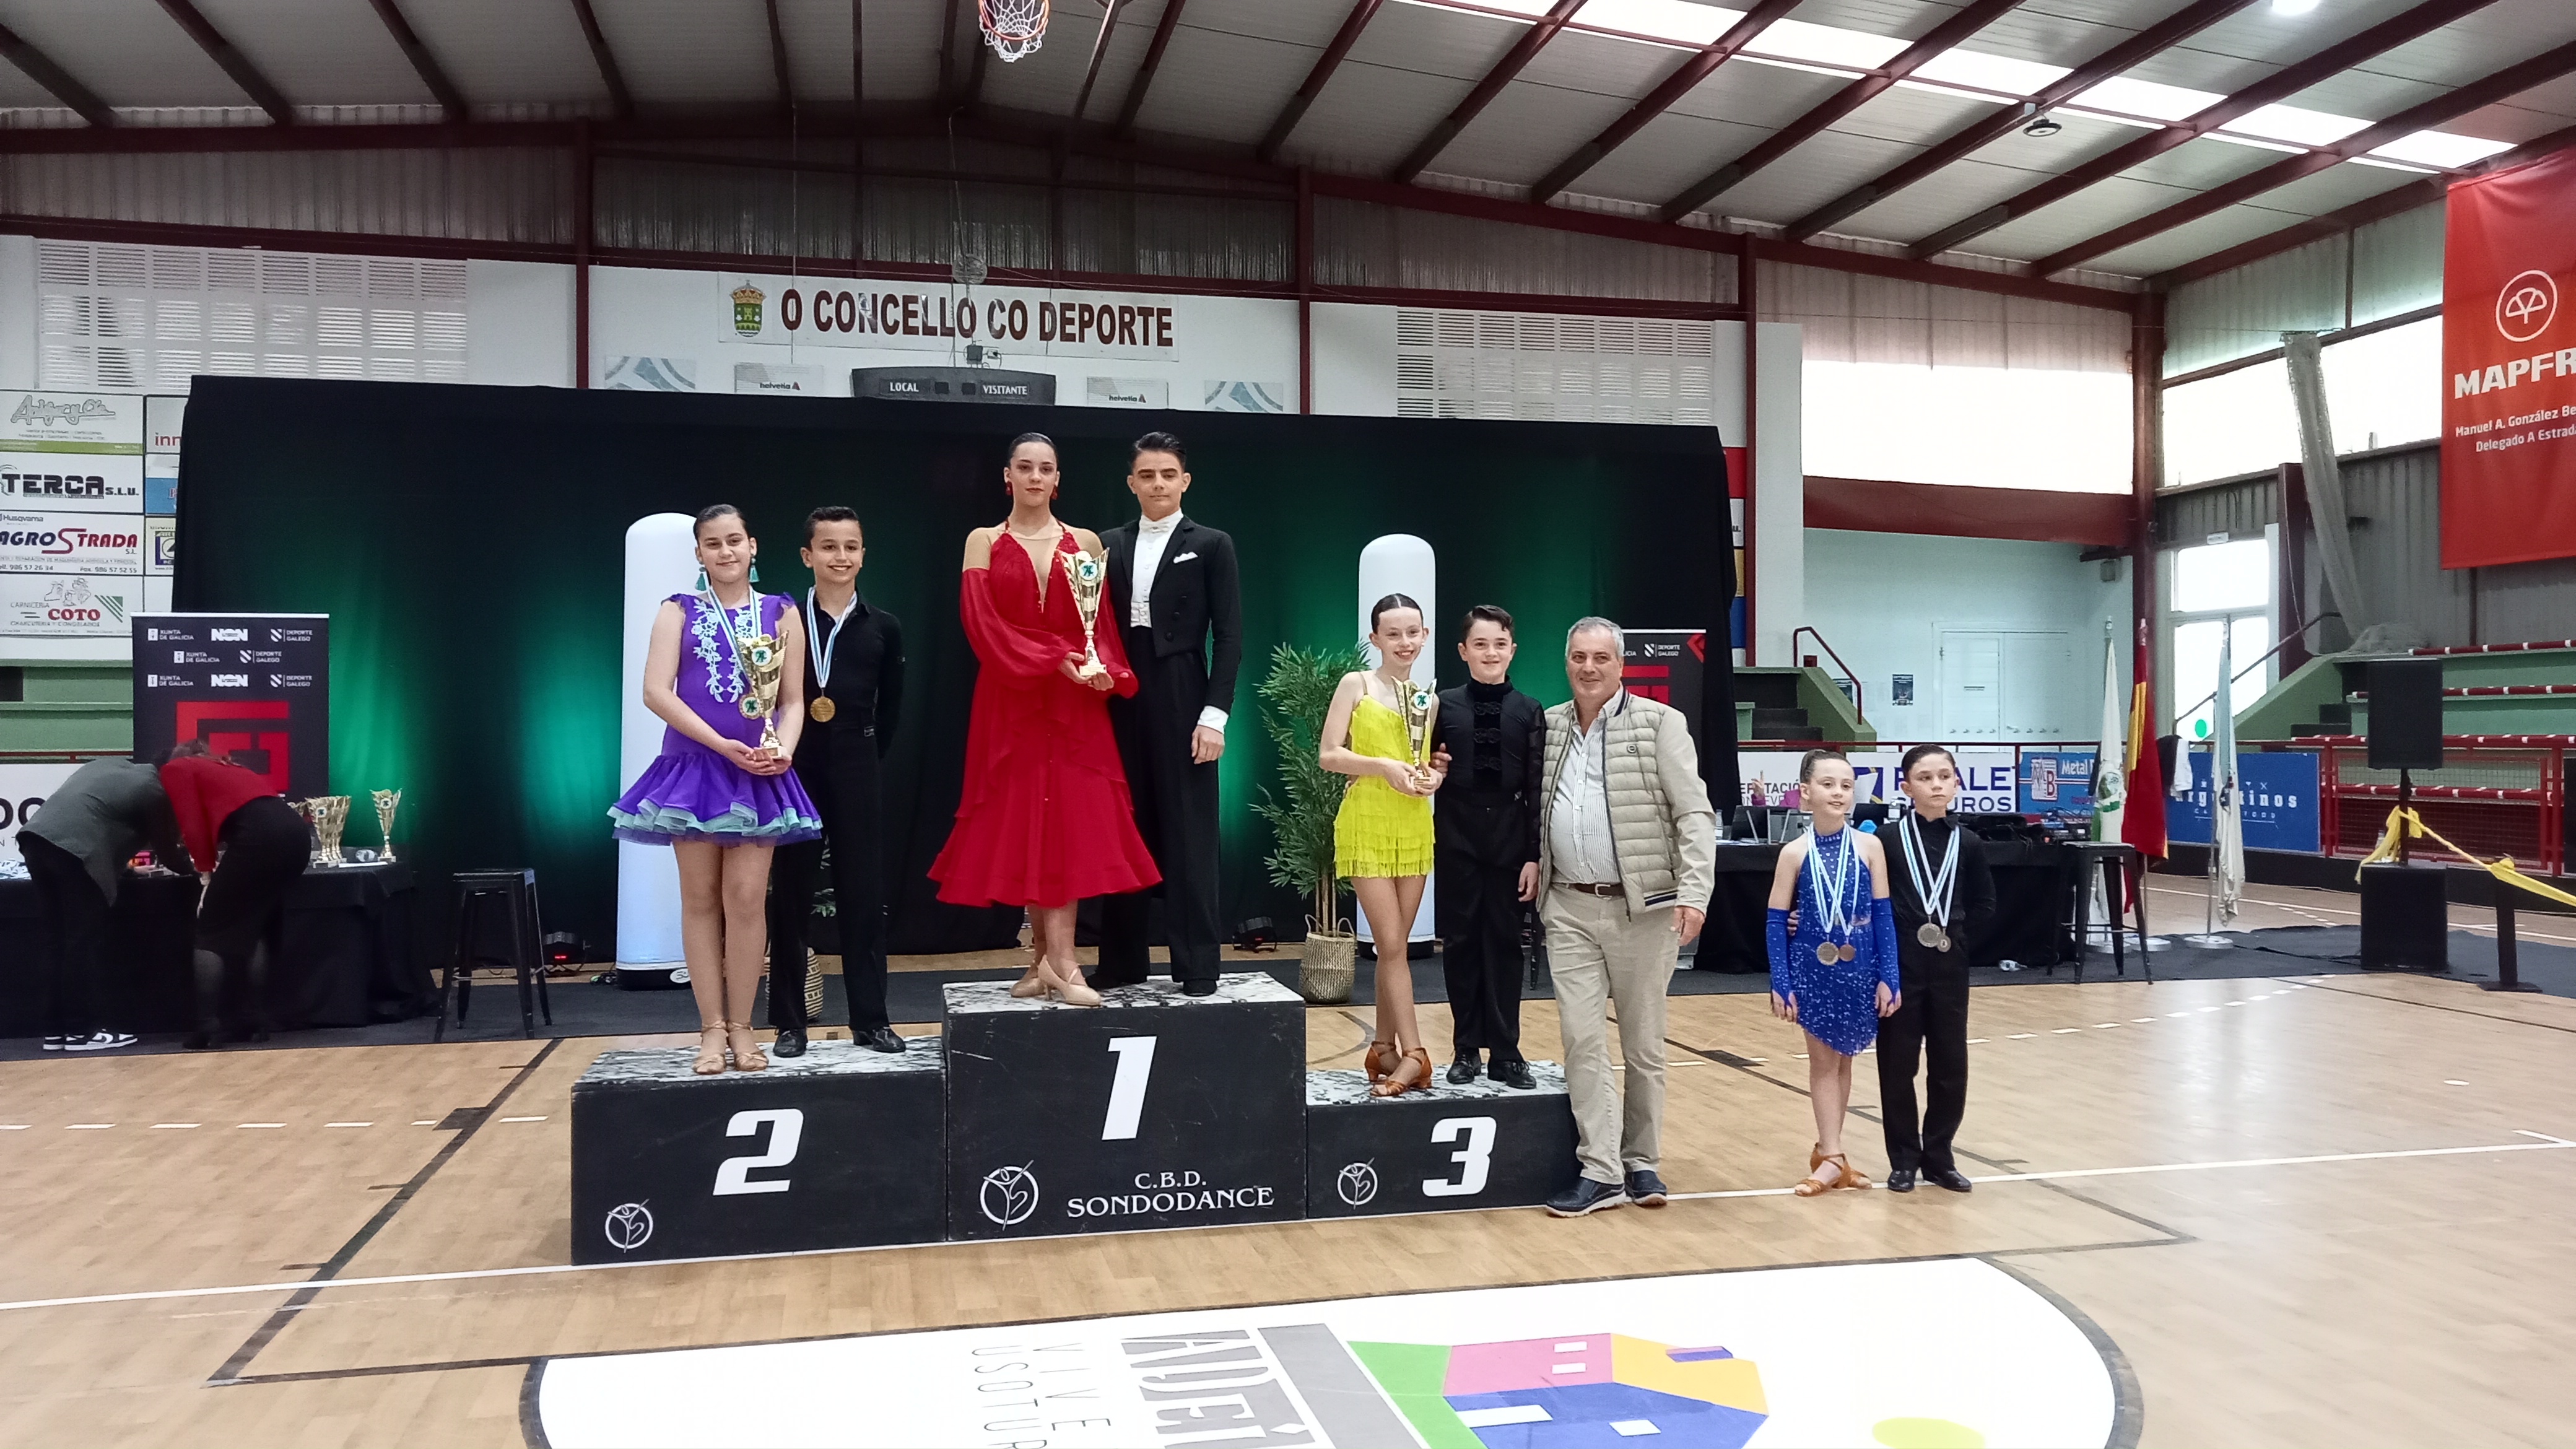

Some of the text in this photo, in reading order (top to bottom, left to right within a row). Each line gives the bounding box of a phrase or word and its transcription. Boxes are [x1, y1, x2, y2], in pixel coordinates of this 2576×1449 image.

[781, 289, 1173, 347] O CONCELLO CO DEPORTE
[890, 382, 919, 393] LOCAL
[983, 385, 1028, 395] VISITANTE
[1109, 394, 1138, 402] helvetia
[2456, 420, 2492, 437] Manuel
[2495, 419, 2505, 430] A.
[2508, 408, 2559, 427] González
[2476, 435, 2525, 453] Delegado
[2527, 432, 2535, 442] A
[2, 473, 104, 495] TERCA
[48, 609, 101, 621] COTO
[2061, 759, 2088, 775] Metal
[1102, 1036, 1157, 1141] 1
[713, 1108, 804, 1196] 2
[1422, 1116, 1497, 1197] 3
[1134, 1171, 1207, 1190] C.B.D.
[1066, 1187, 1276, 1218] SONDODANCE
